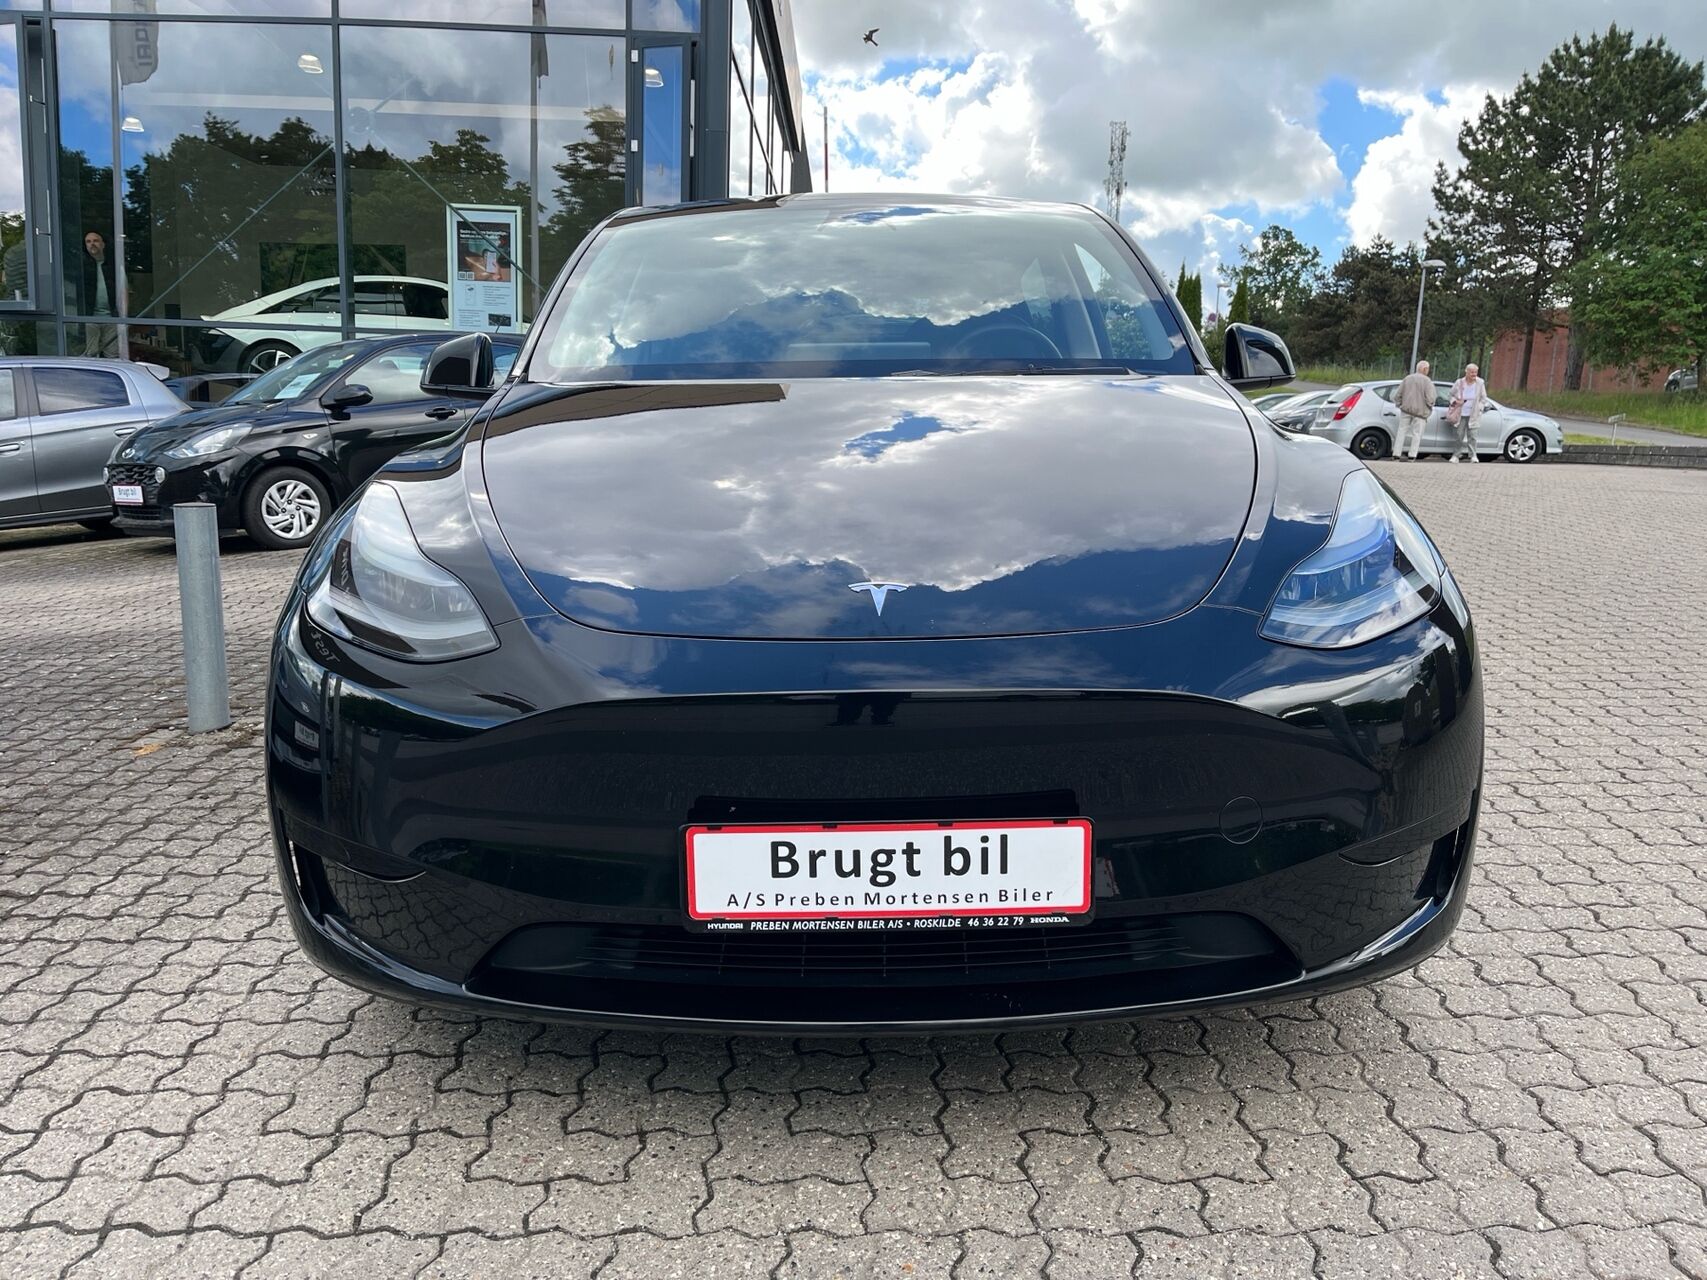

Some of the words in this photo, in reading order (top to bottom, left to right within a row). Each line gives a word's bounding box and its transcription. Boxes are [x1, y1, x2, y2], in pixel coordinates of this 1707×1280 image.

[770, 841, 921, 888] Brugt
[943, 834, 1008, 876] bil
[727, 892, 766, 909] A/S
[775, 892, 855, 906] Preben
[864, 892, 989, 906] Mortensen
[998, 888, 1053, 902] Biler
[707, 922, 744, 930] HYUNDAI
[750, 921, 790, 931] PREBEN
[792, 920, 854, 930] MORTENSEN
[857, 920, 886, 930] BILER
[887, 919, 903, 929] A/S
[913, 918, 961, 928] ROSKILDE
[967, 917, 980, 927] 46
[982, 917, 994, 927] 36
[997, 916, 1009, 926] 22
[1012, 916, 1025, 926] 79
[1030, 915, 1070, 924] HONDA
